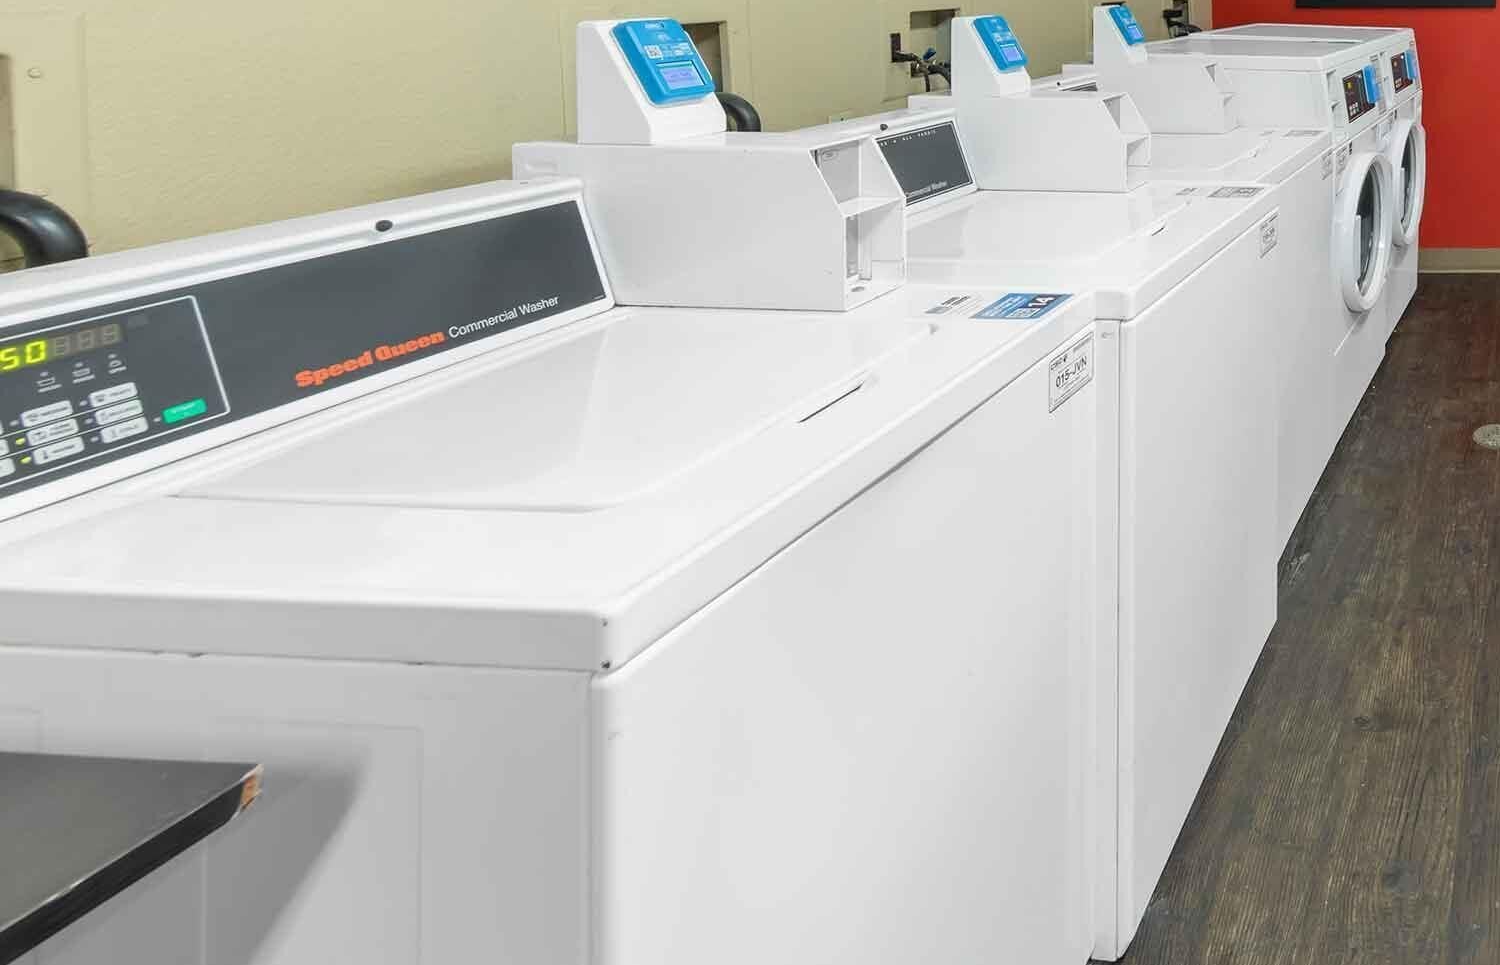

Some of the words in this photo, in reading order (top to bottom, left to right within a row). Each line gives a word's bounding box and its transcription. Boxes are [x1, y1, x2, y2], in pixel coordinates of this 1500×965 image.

[295, 351, 374, 387] Speed
[374, 331, 447, 362] Queen
[448, 307, 517, 339] Commercial
[518, 295, 560, 316] Washer
[1055, 355, 1088, 388] 015-JVN
